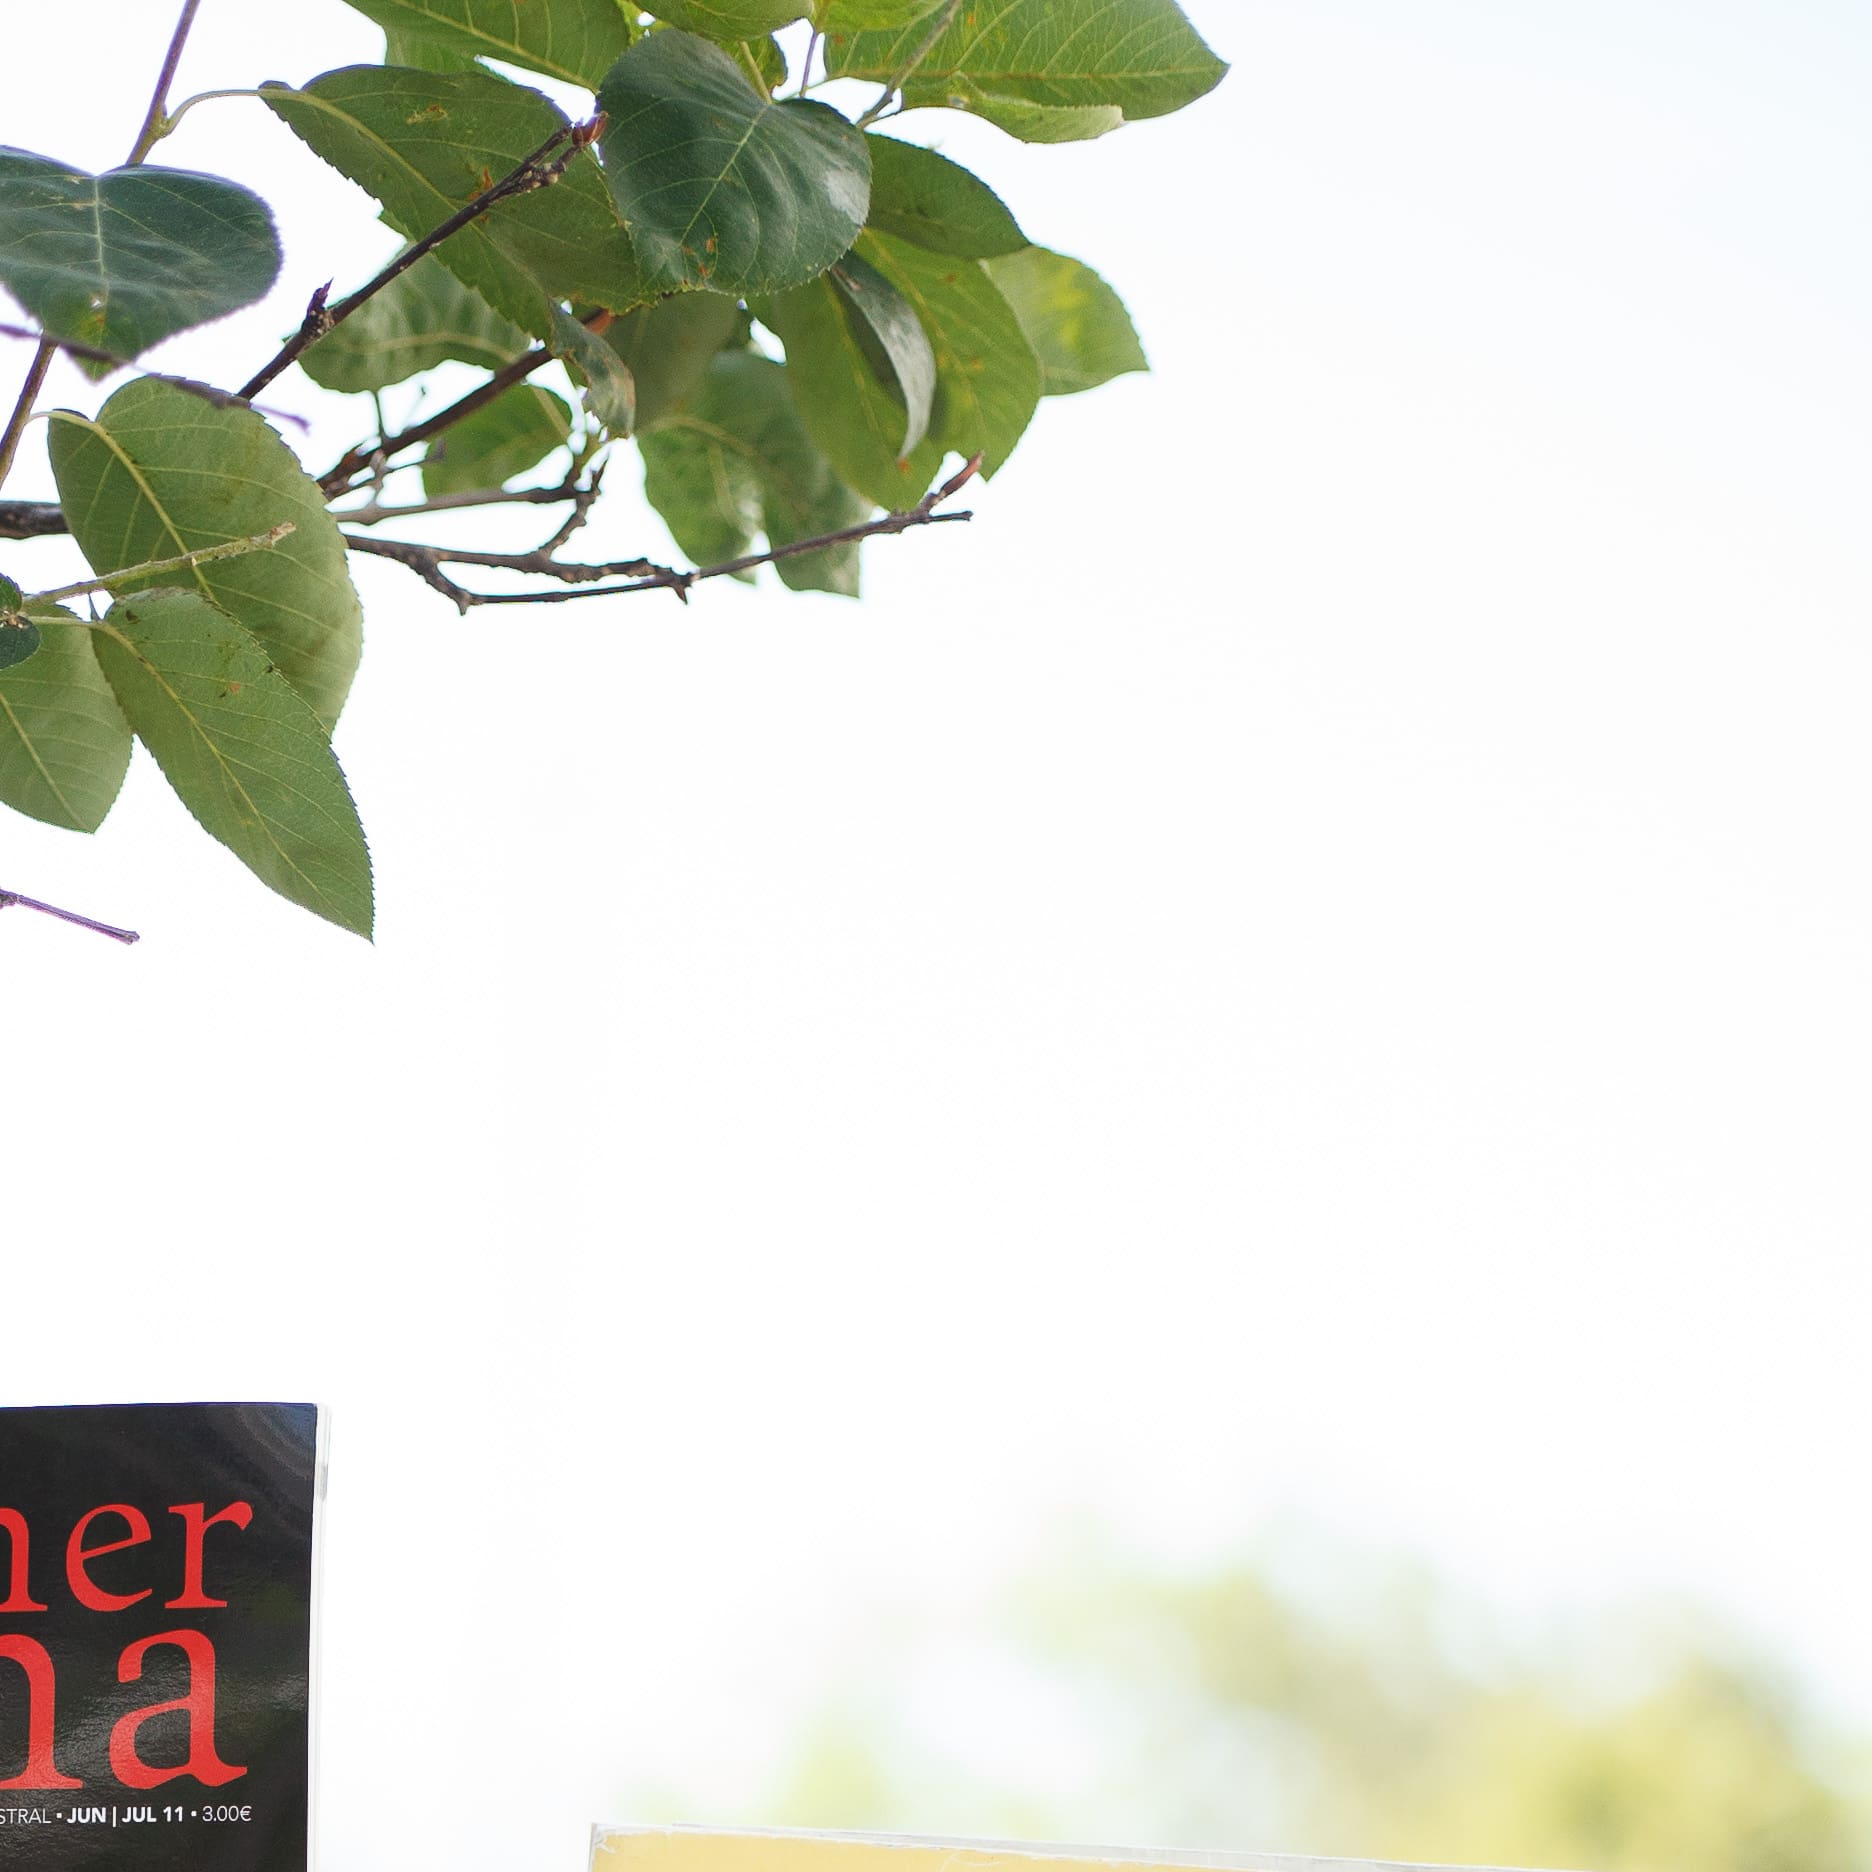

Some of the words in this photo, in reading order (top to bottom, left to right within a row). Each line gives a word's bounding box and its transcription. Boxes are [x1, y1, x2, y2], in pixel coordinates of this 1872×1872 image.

[66, 1807, 107, 1824] JUN
[121, 1806, 157, 1823] JUL
[163, 1806, 183, 1822] 11
[202, 1805, 252, 1822] 3.00€
